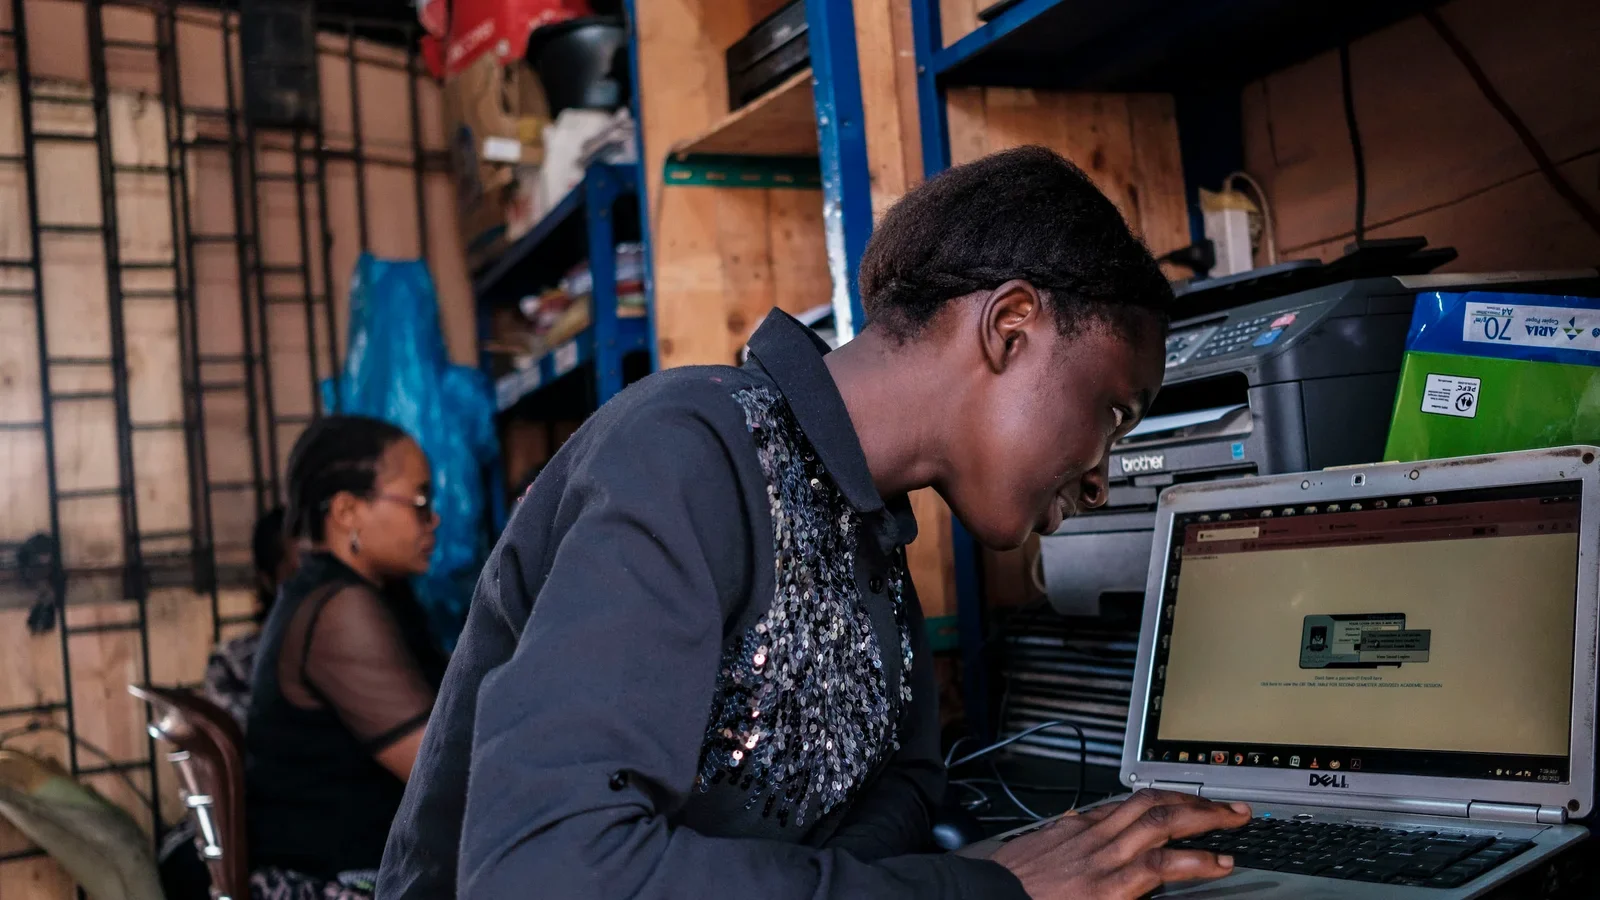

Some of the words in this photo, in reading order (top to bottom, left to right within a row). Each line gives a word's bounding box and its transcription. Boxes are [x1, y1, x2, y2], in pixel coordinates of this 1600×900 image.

[1484, 317, 1512, 340] 70
[1525, 325, 1558, 337] ARIA
[1121, 455, 1164, 472] brother
[1309, 774, 1349, 788] DELL
